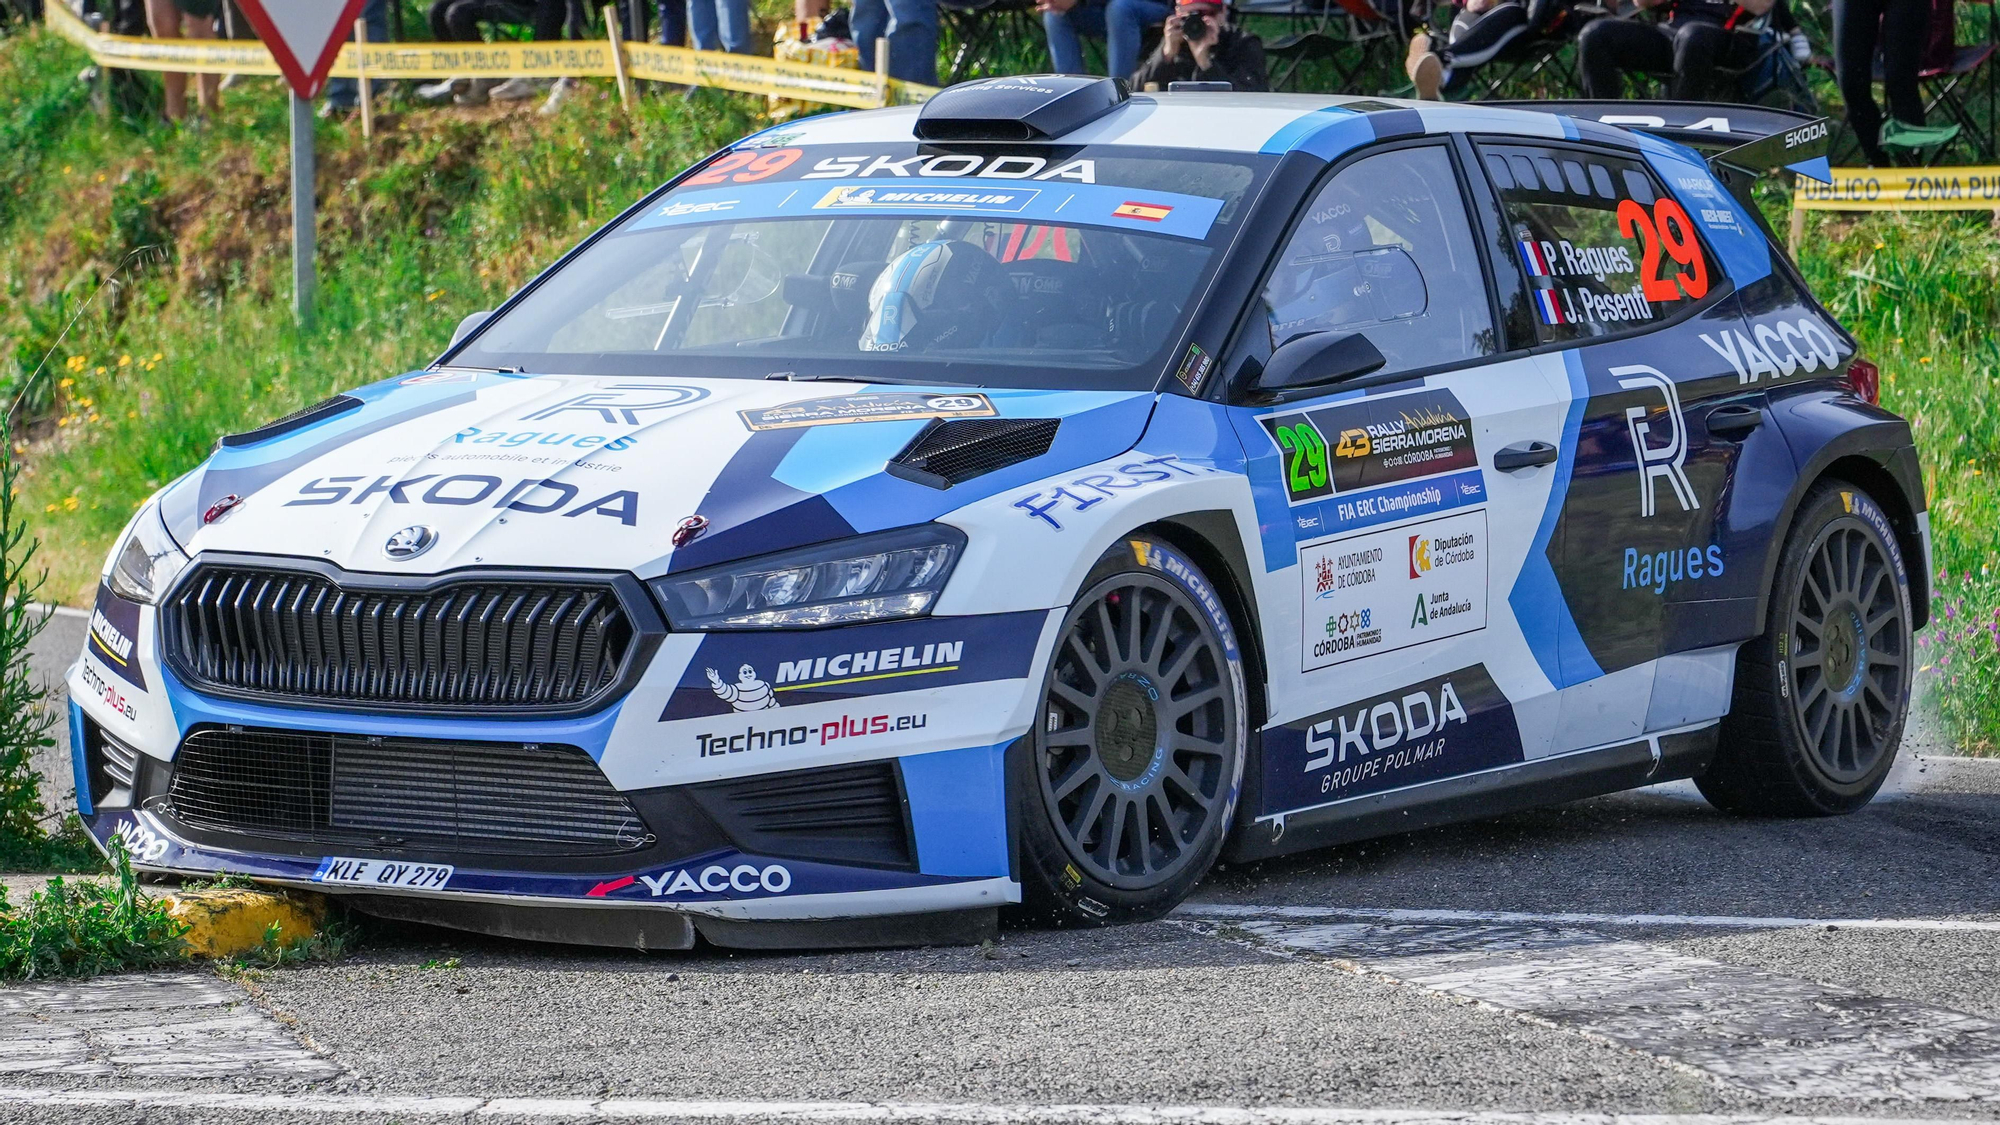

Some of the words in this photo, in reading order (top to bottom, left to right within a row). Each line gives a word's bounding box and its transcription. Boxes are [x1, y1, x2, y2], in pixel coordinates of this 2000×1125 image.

[432, 51, 458, 70] ZONA
[463, 50, 511, 70] PUBLICO
[523, 50, 550, 69] ZONA
[555, 49, 604, 69] PUBLICO
[994, 83, 1055, 95] Services
[1785, 122, 1829, 150] SKODA
[679, 148, 803, 186] 29
[877, 190, 1016, 206] MICHELIN
[1904, 176, 1962, 201] ZONA
[1541, 240, 1566, 277] P.
[1560, 240, 1635, 283] Ragues
[1616, 197, 1709, 303] 29
[1562, 287, 1584, 325] J.
[1577, 284, 1654, 323] Pesenti
[1698, 318, 1841, 385] YACCO
[934, 398, 975, 408] 29
[1368, 419, 1406, 438] RALLY
[1399, 404, 1460, 431] Andalucía
[440, 426, 639, 452] Ragues
[1335, 427, 1371, 459] 43
[1371, 435, 1416, 455] SIERRA
[1415, 424, 1467, 446] MORENA
[531, 455, 550, 465] et
[552, 457, 623, 473] inustrie
[1276, 422, 1328, 493] 29
[1403, 449, 1435, 465] CÓRDOBA
[283, 473, 640, 527] SKODA
[1337, 504, 1355, 522] FIA
[1357, 499, 1376, 517] ERC
[1378, 488, 1442, 514] Championship
[1434, 532, 1474, 553] Diputación
[1861, 501, 1905, 577] MICHELIN
[1337, 547, 1384, 570] AYUNTAMIENTO
[1434, 554, 1444, 568] de
[1444, 547, 1475, 566] Córdoba
[1622, 543, 1725, 595] Ragues
[1337, 577, 1347, 589] DE
[1347, 568, 1377, 587] CÓRDOBA
[1165, 556, 1236, 651] MICHELIN
[1429, 608, 1439, 620] de
[1439, 598, 1472, 617] Andalucía
[1430, 591, 1450, 605] Junta
[1313, 634, 1356, 658] CÓRDOBA
[775, 640, 965, 684] MICHELIN
[696, 713, 928, 758] Techno-plus.eu
[1121, 747, 1164, 791] RACING
[1320, 757, 1383, 795] GROUPE
[1383, 737, 1447, 774] POLMAR
[326, 860, 369, 882] KLE
[377, 863, 411, 884] QY
[407, 865, 450, 888] 279
[639, 864, 792, 898] YACCO
